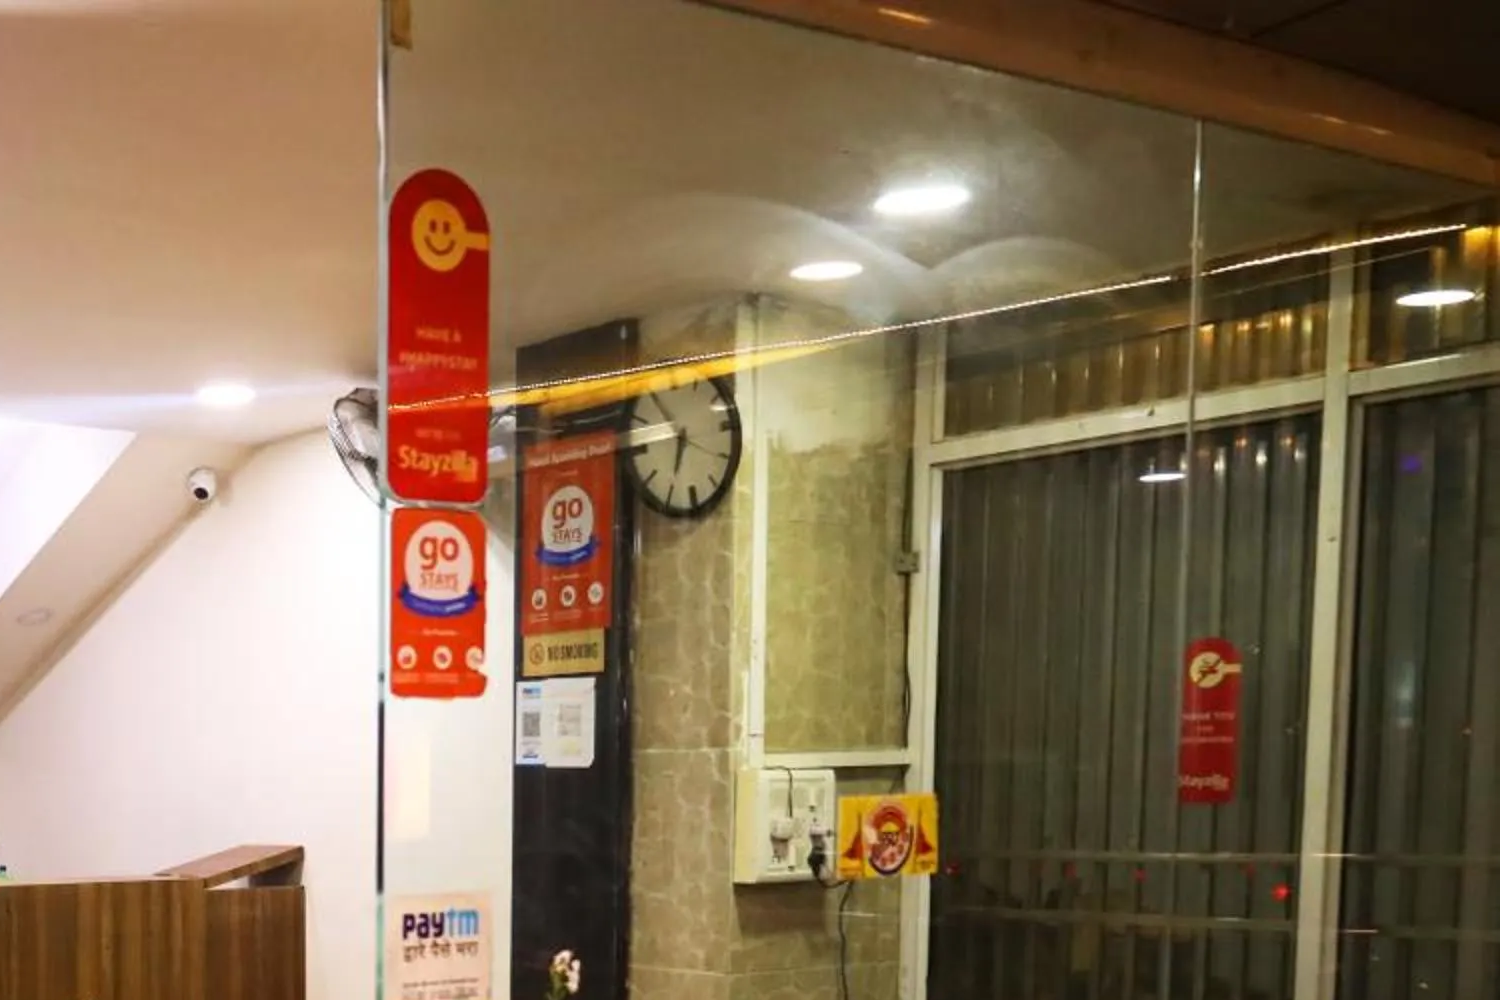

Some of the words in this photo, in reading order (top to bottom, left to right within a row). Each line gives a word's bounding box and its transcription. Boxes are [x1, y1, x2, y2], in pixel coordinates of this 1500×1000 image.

[552, 498, 583, 529] go
[419, 536, 460, 571] go
[419, 571, 459, 592] STAYS
